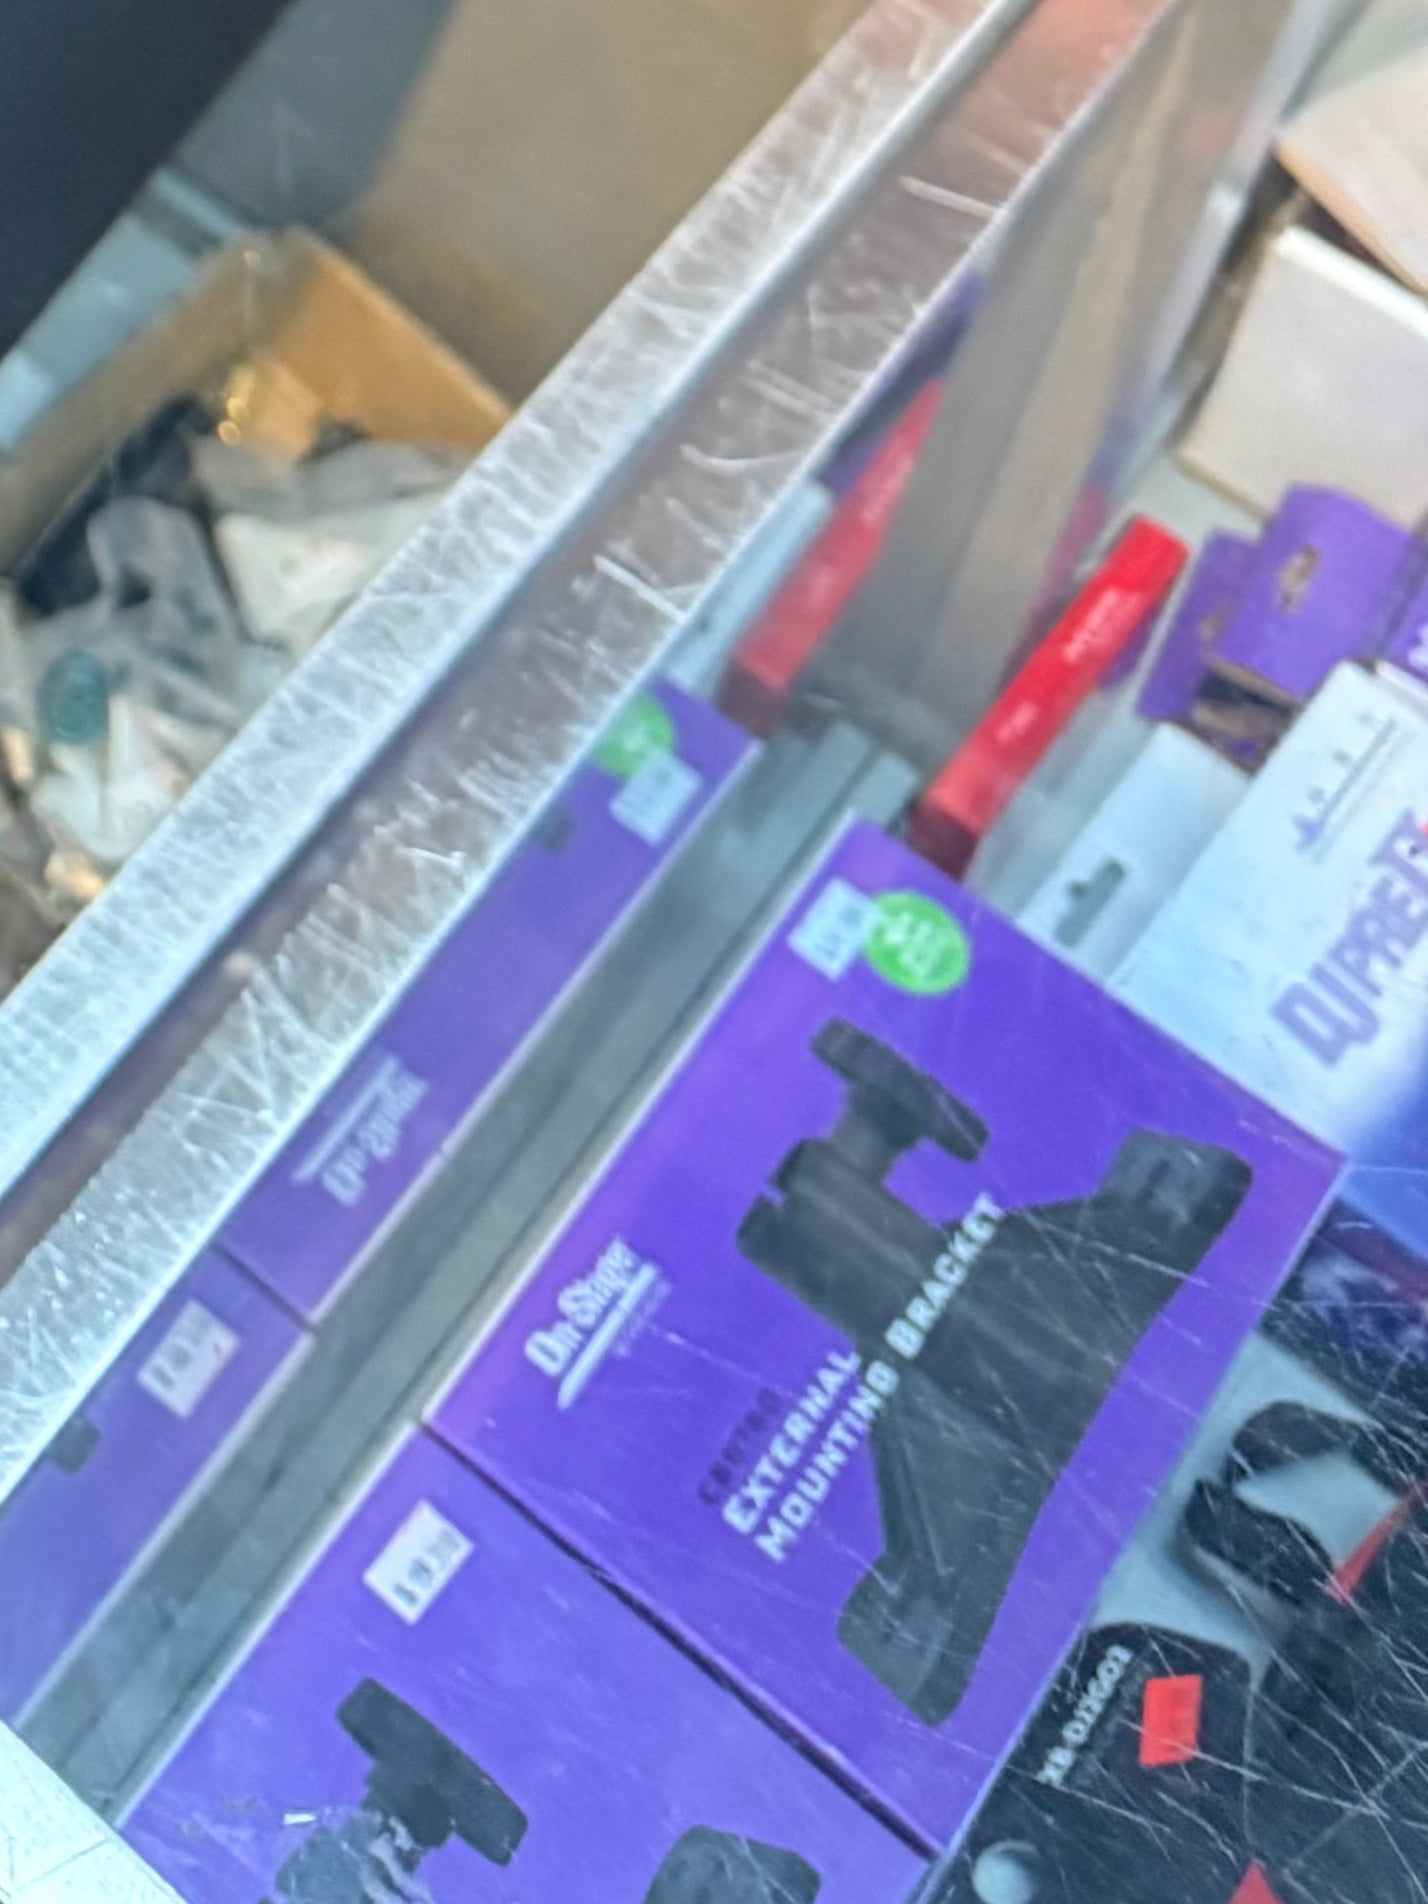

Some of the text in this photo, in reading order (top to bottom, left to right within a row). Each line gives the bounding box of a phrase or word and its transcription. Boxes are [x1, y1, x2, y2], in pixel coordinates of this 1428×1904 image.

[722, 1351, 862, 1534] EXTERNAL
[754, 1192, 1003, 1564] MOUNTING BRACKET
